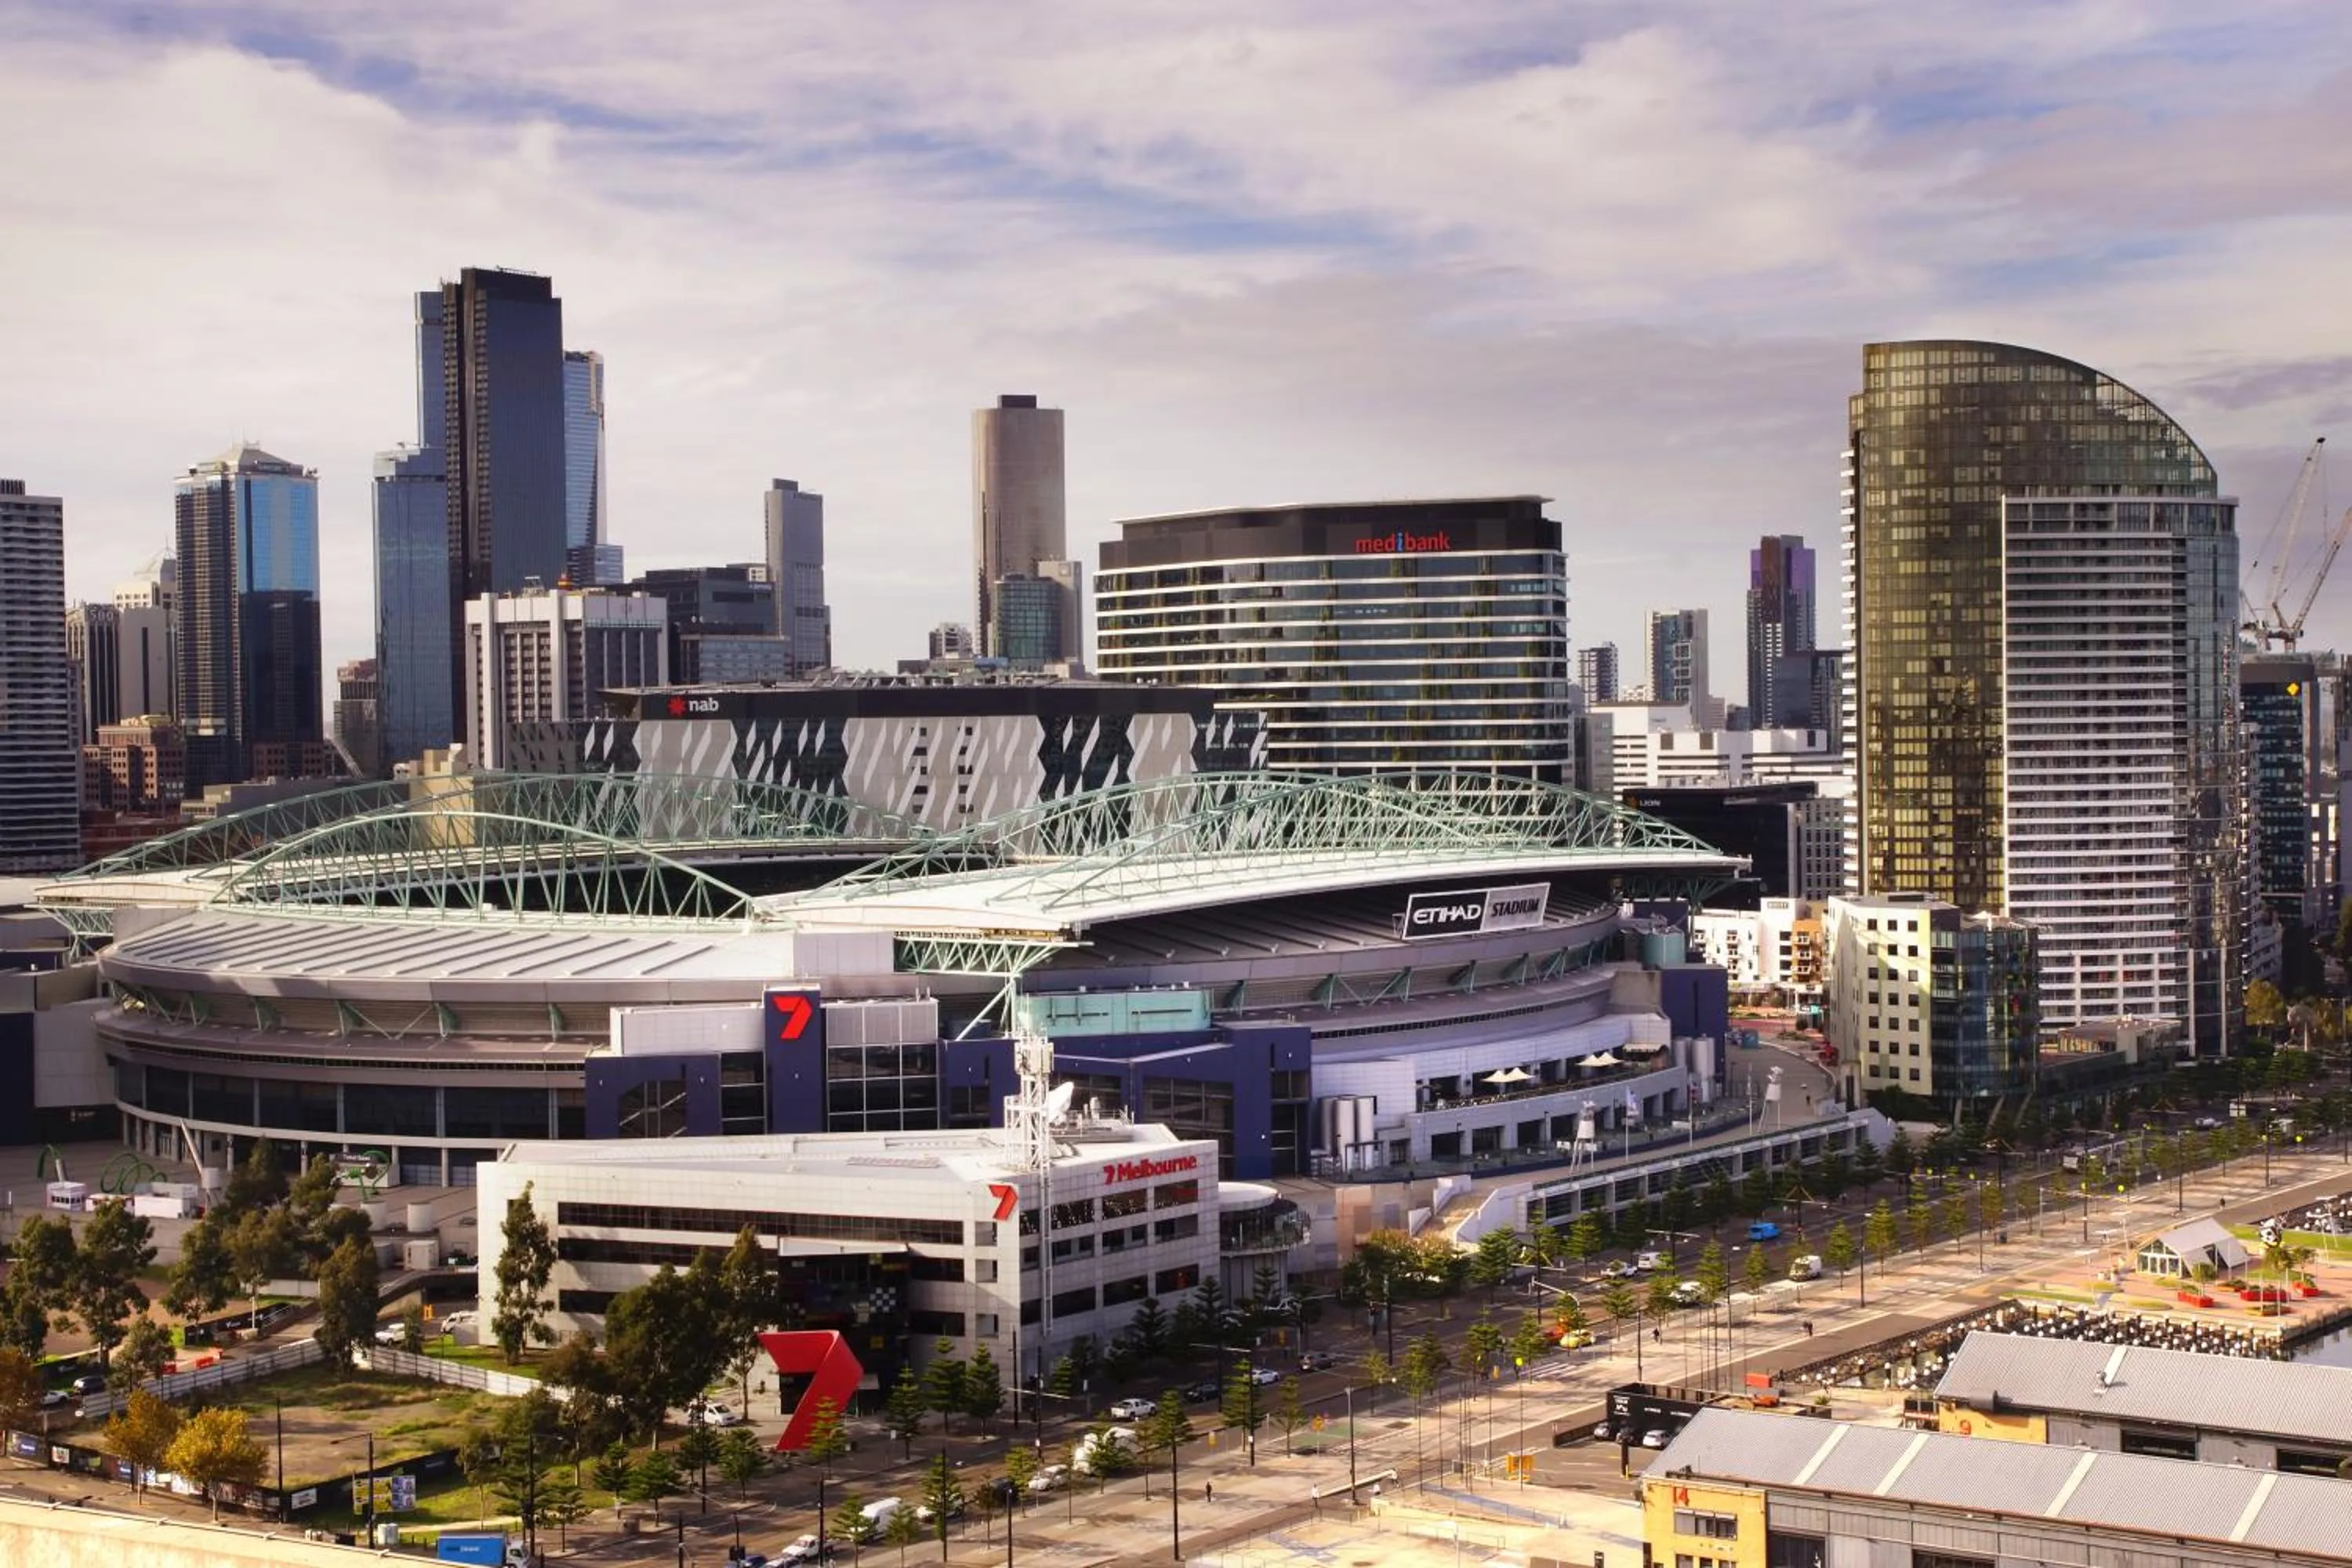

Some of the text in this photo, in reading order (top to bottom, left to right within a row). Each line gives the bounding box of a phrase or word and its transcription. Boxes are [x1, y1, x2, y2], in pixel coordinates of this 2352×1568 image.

[1356, 531, 1450, 553] medibank
[689, 697, 719, 712] nab
[1414, 898, 1540, 924] ETIHAD STADIUM
[772, 995, 812, 1040] 7
[1103, 1155, 1198, 1185] 7 Melbourne
[989, 1184, 1018, 1221] 7
[758, 1330, 864, 1452] 7
